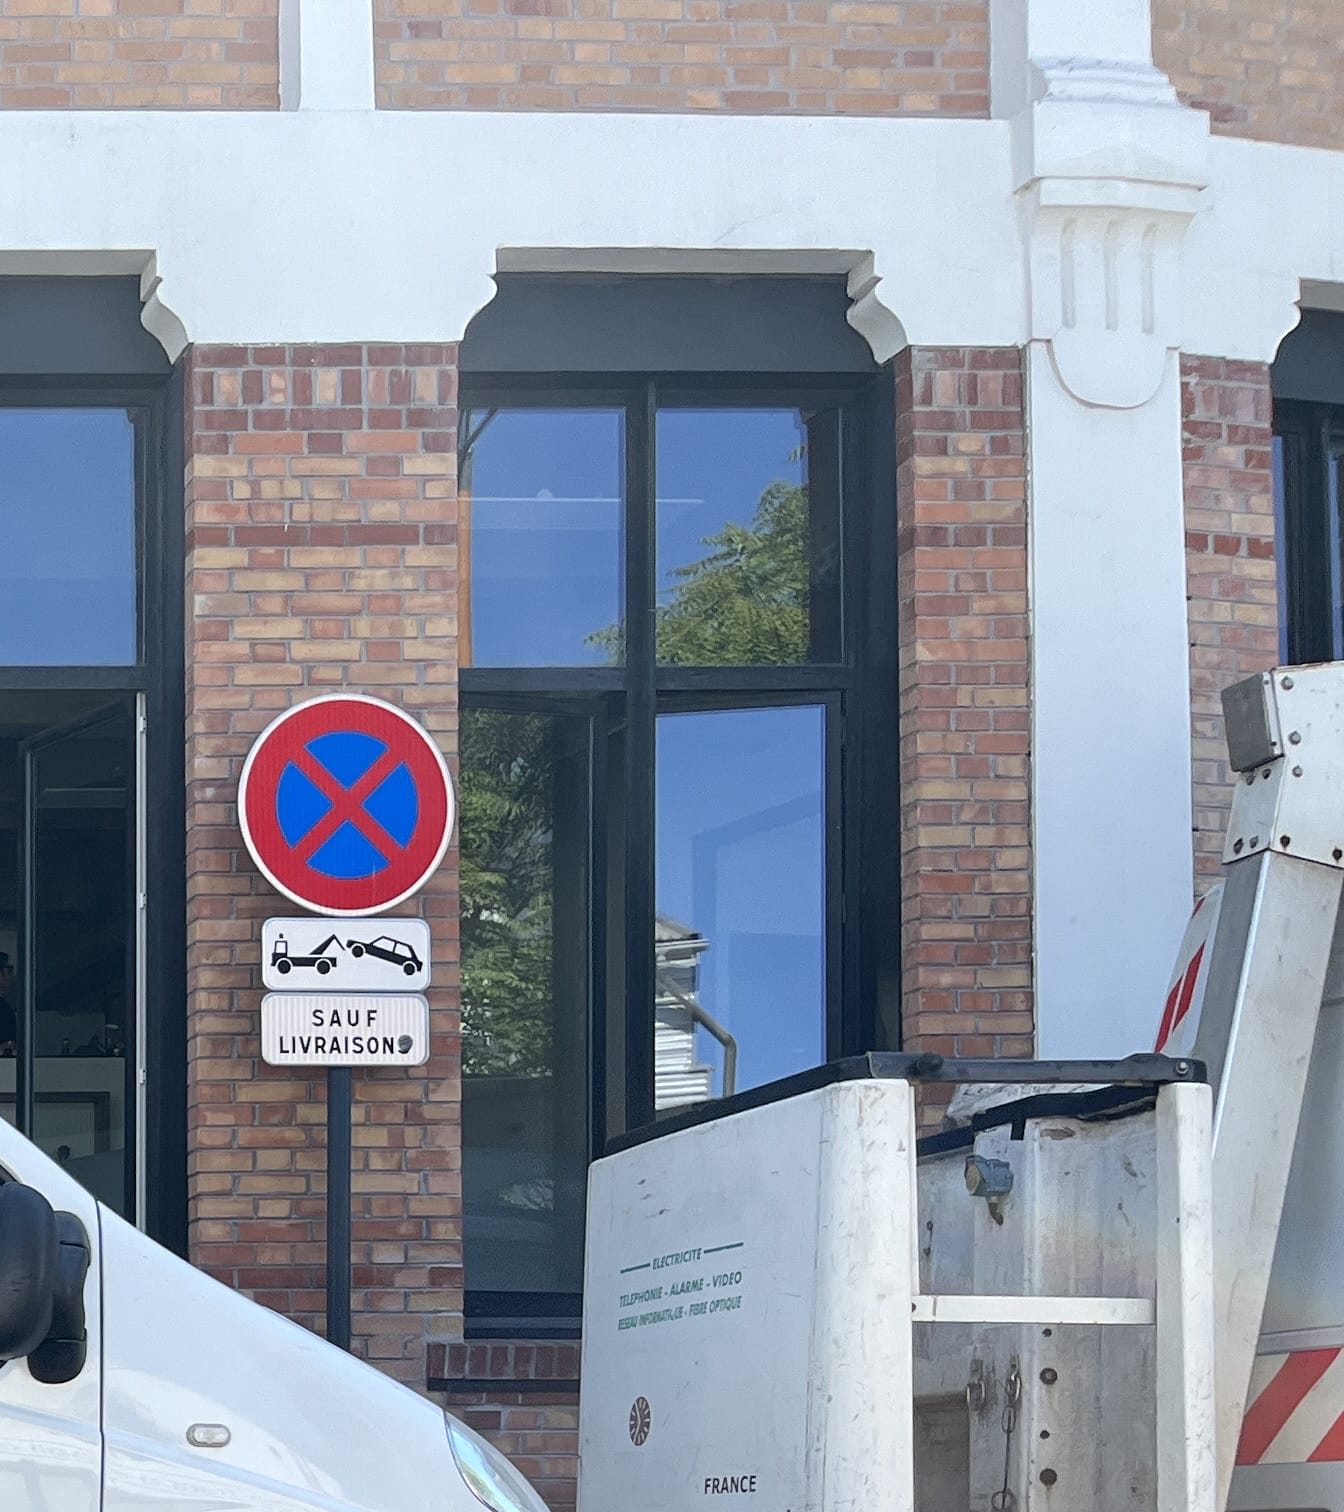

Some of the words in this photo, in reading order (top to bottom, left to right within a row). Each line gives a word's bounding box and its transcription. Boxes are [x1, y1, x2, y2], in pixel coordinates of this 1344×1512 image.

[311, 1009, 378, 1028] SAUF
[652, 1247, 702, 1271] ELECTRICITE
[619, 1286, 663, 1308] TELEPHONIE
[669, 1277, 704, 1296] ALARME
[712, 1271, 742, 1288] VIDEO
[704, 1474, 757, 1495] FRANCE
